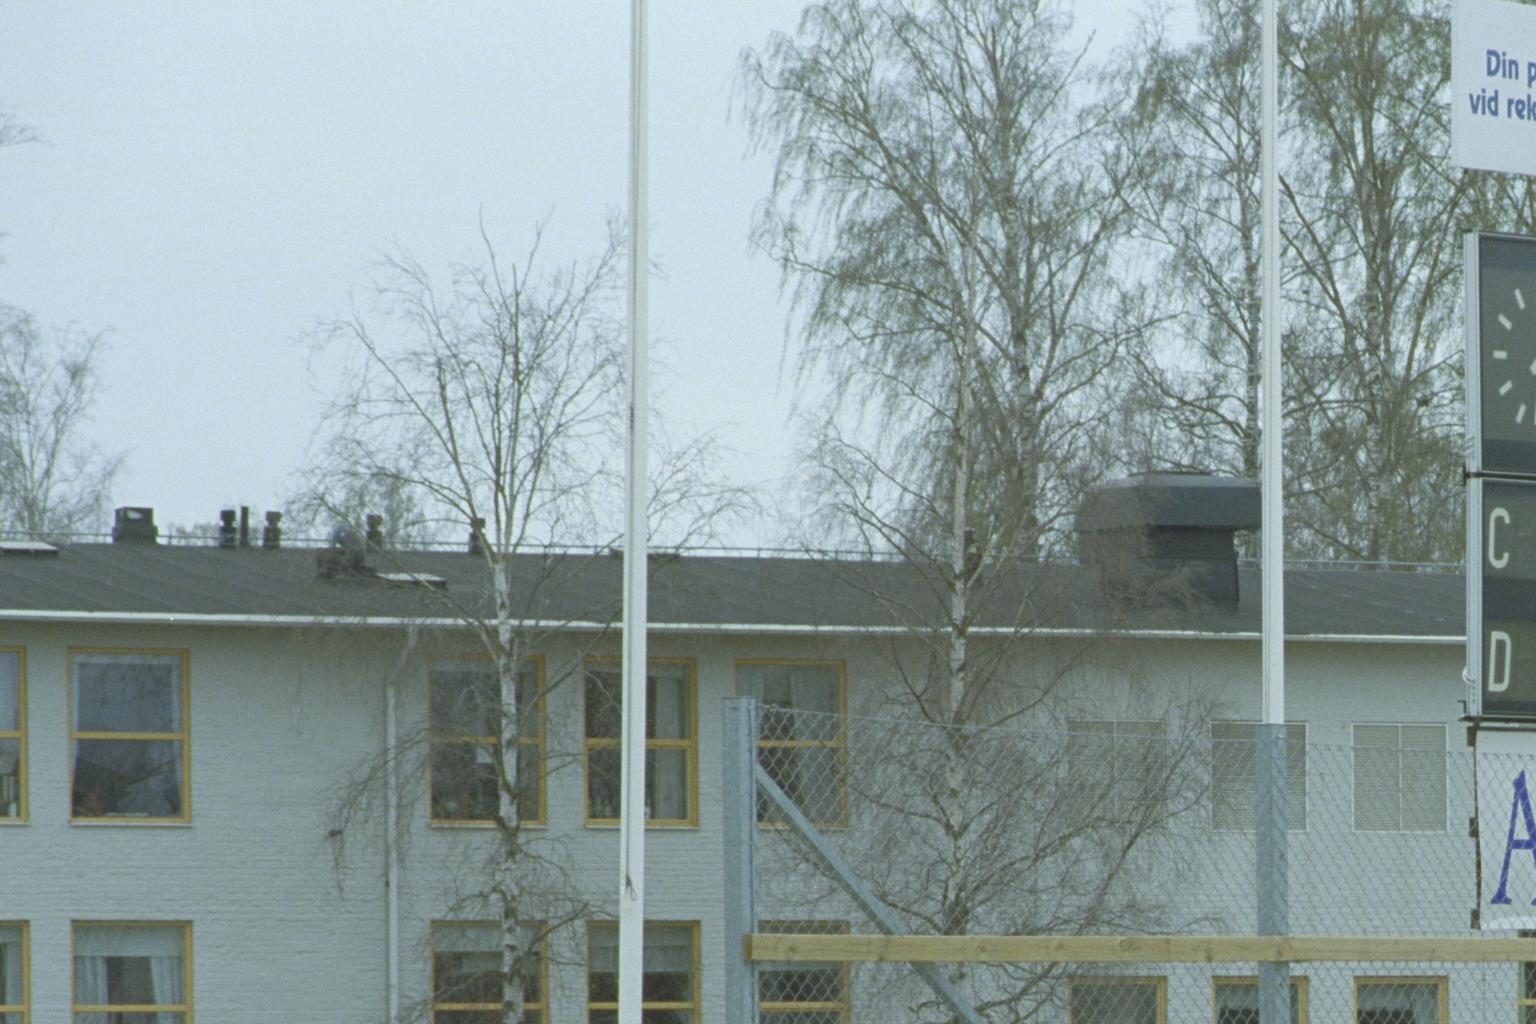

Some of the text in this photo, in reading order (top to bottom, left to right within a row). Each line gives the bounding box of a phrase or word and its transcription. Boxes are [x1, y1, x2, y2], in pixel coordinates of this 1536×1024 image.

[1486, 49, 1519, 80] Din
[1469, 88, 1499, 117] vid
[1489, 508, 1510, 568] C
[1488, 631, 1511, 692] D
